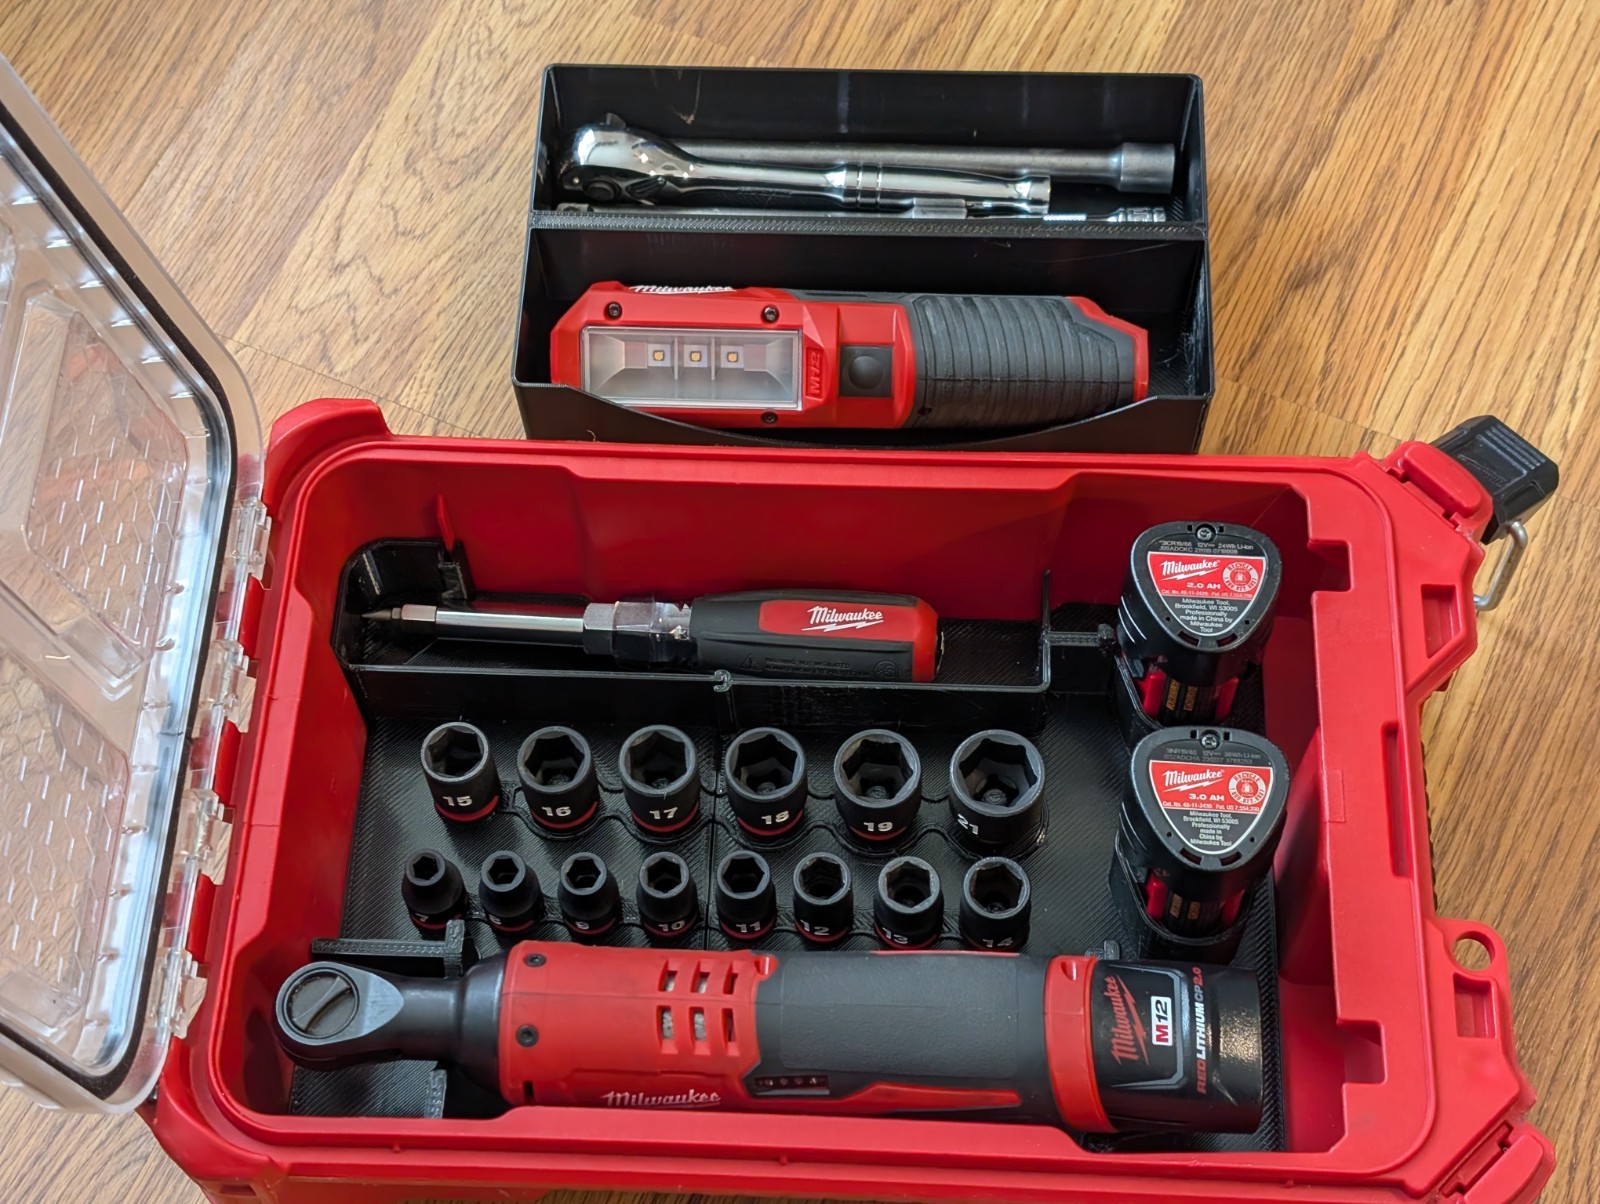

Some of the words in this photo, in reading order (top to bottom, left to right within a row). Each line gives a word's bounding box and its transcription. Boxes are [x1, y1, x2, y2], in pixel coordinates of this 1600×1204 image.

[809, 352, 821, 394] M12
[1160, 560, 1219, 576] Milwaukee
[807, 606, 884, 624] Milwaukee
[1162, 769, 1223, 786] Milwaukee
[1234, 772, 1261, 782] RECYCLE
[442, 795, 473, 806] 15
[541, 806, 572, 817] 16
[649, 808, 679, 820] 17
[761, 810, 790, 824] 18
[864, 821, 894, 832] 19
[957, 813, 979, 836] 21
[1192, 822, 1230, 830] Professionally
[658, 920, 686, 932] 10
[736, 921, 762, 933] 11
[800, 919, 830, 936] 12
[882, 927, 908, 944] 13
[982, 937, 1014, 948] 14
[1103, 976, 1140, 1064] Milwaukee
[1155, 999, 1169, 1044] M12
[601, 1088, 721, 1107] Milwaukee
